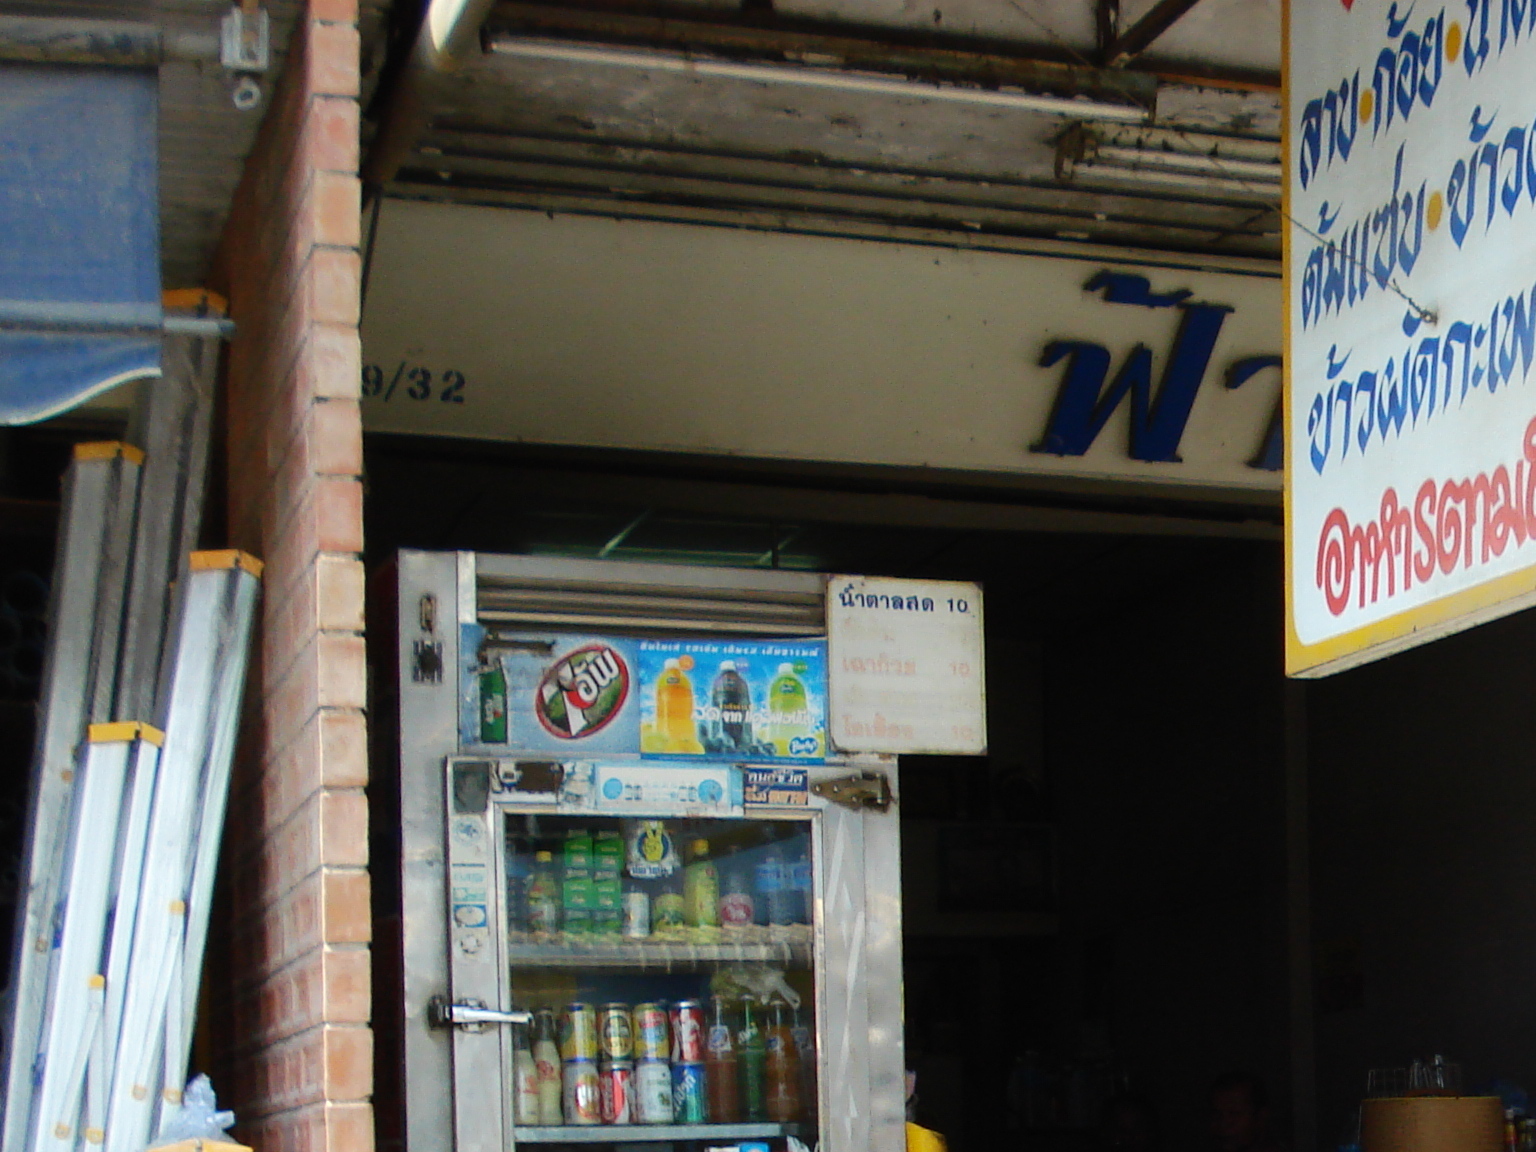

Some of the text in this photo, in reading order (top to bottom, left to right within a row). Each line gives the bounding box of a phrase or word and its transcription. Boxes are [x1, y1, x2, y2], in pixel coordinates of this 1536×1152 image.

[839, 583, 968, 613] น้ำตาลสด 10
